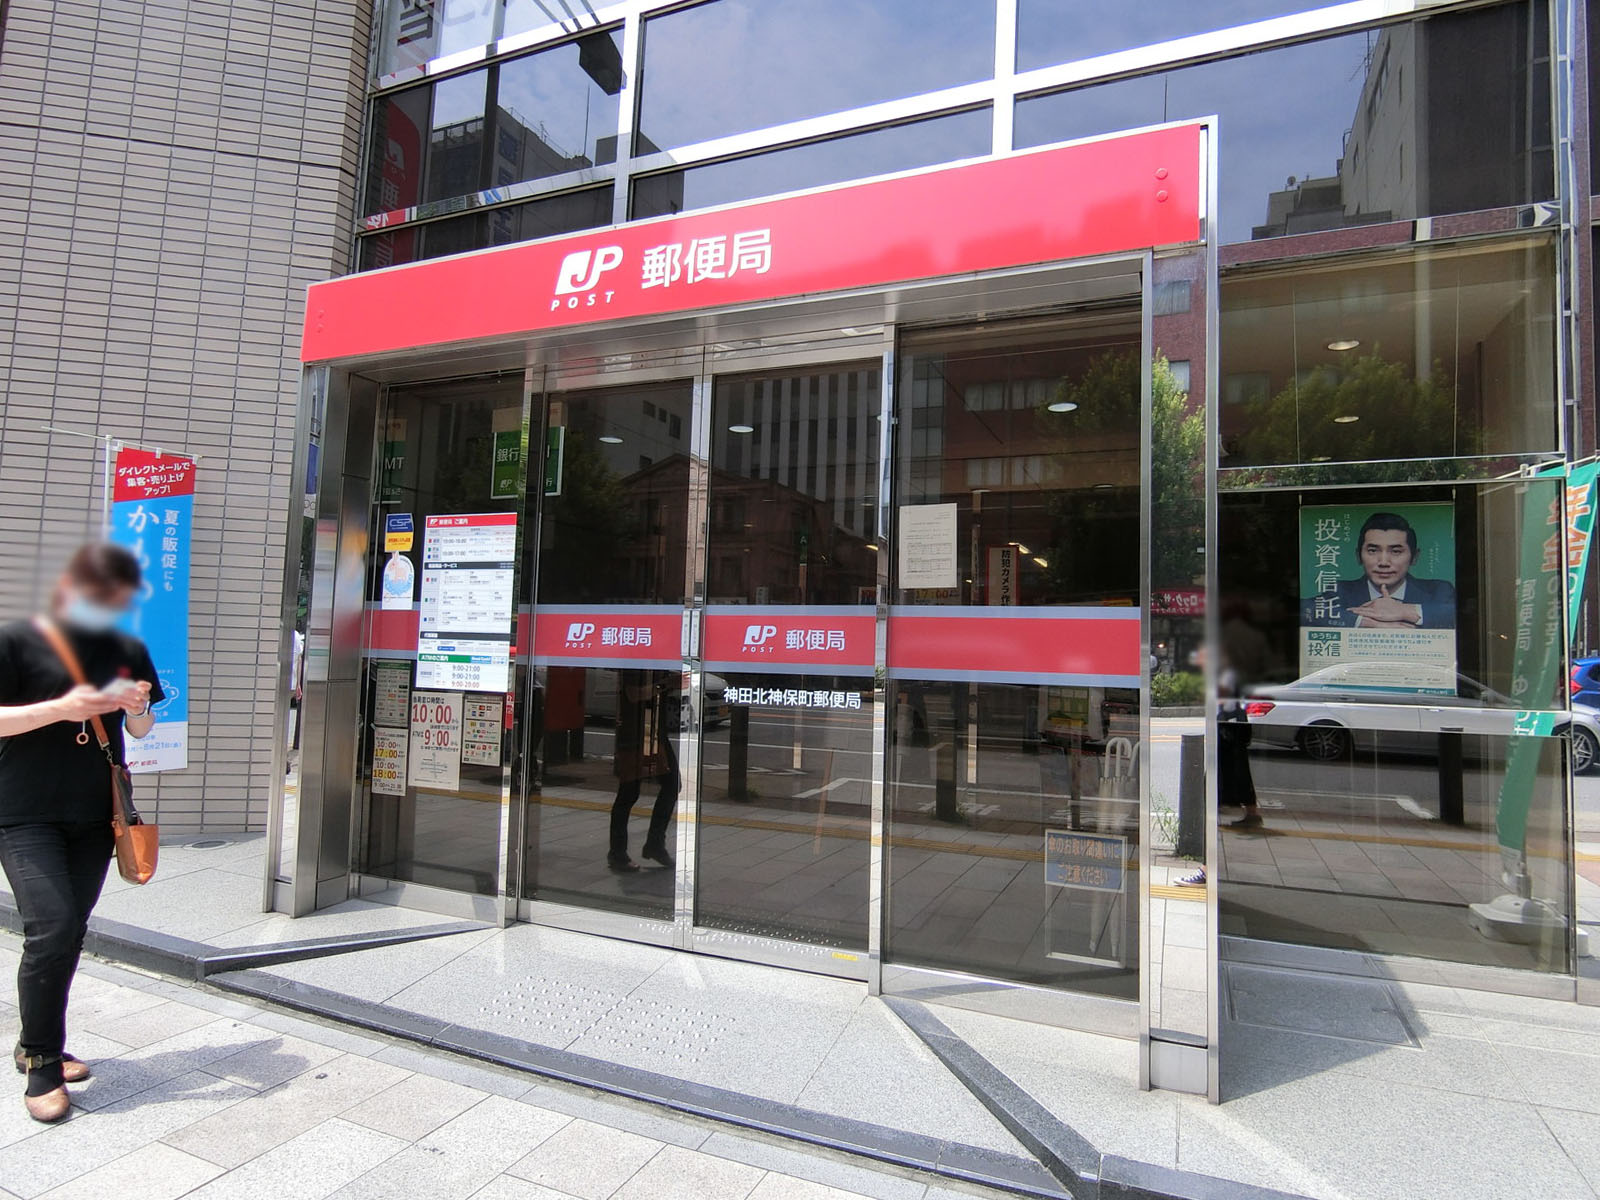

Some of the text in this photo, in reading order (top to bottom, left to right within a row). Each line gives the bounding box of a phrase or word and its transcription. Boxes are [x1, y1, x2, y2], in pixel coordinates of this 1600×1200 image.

[641, 228, 772, 289] 郵便局
[555, 245, 624, 295] JP
[551, 291, 615, 312] POST
[119, 461, 190, 477] ダイレクトメールで
[127, 473, 185, 487] 集客・売り上げ
[161, 508, 182, 592] 夏の販促にも
[1314, 518, 1341, 619] 投資信託
[566, 622, 595, 642] JP
[601, 627, 652, 647] 郵便局
[743, 625, 777, 645] JP
[786, 629, 846, 651] 郵便局
[1311, 632, 1338, 640] ゆうちょ
[1308, 642, 1341, 657] 投信
[723, 686, 862, 710] 神田北神保町郵便局
[412, 704, 452, 724] 10:00
[424, 729, 450, 746] 9:00
[375, 748, 398, 759] 17:00
[373, 769, 397, 779] 18:00
[376, 761, 395, 769] 10:00
